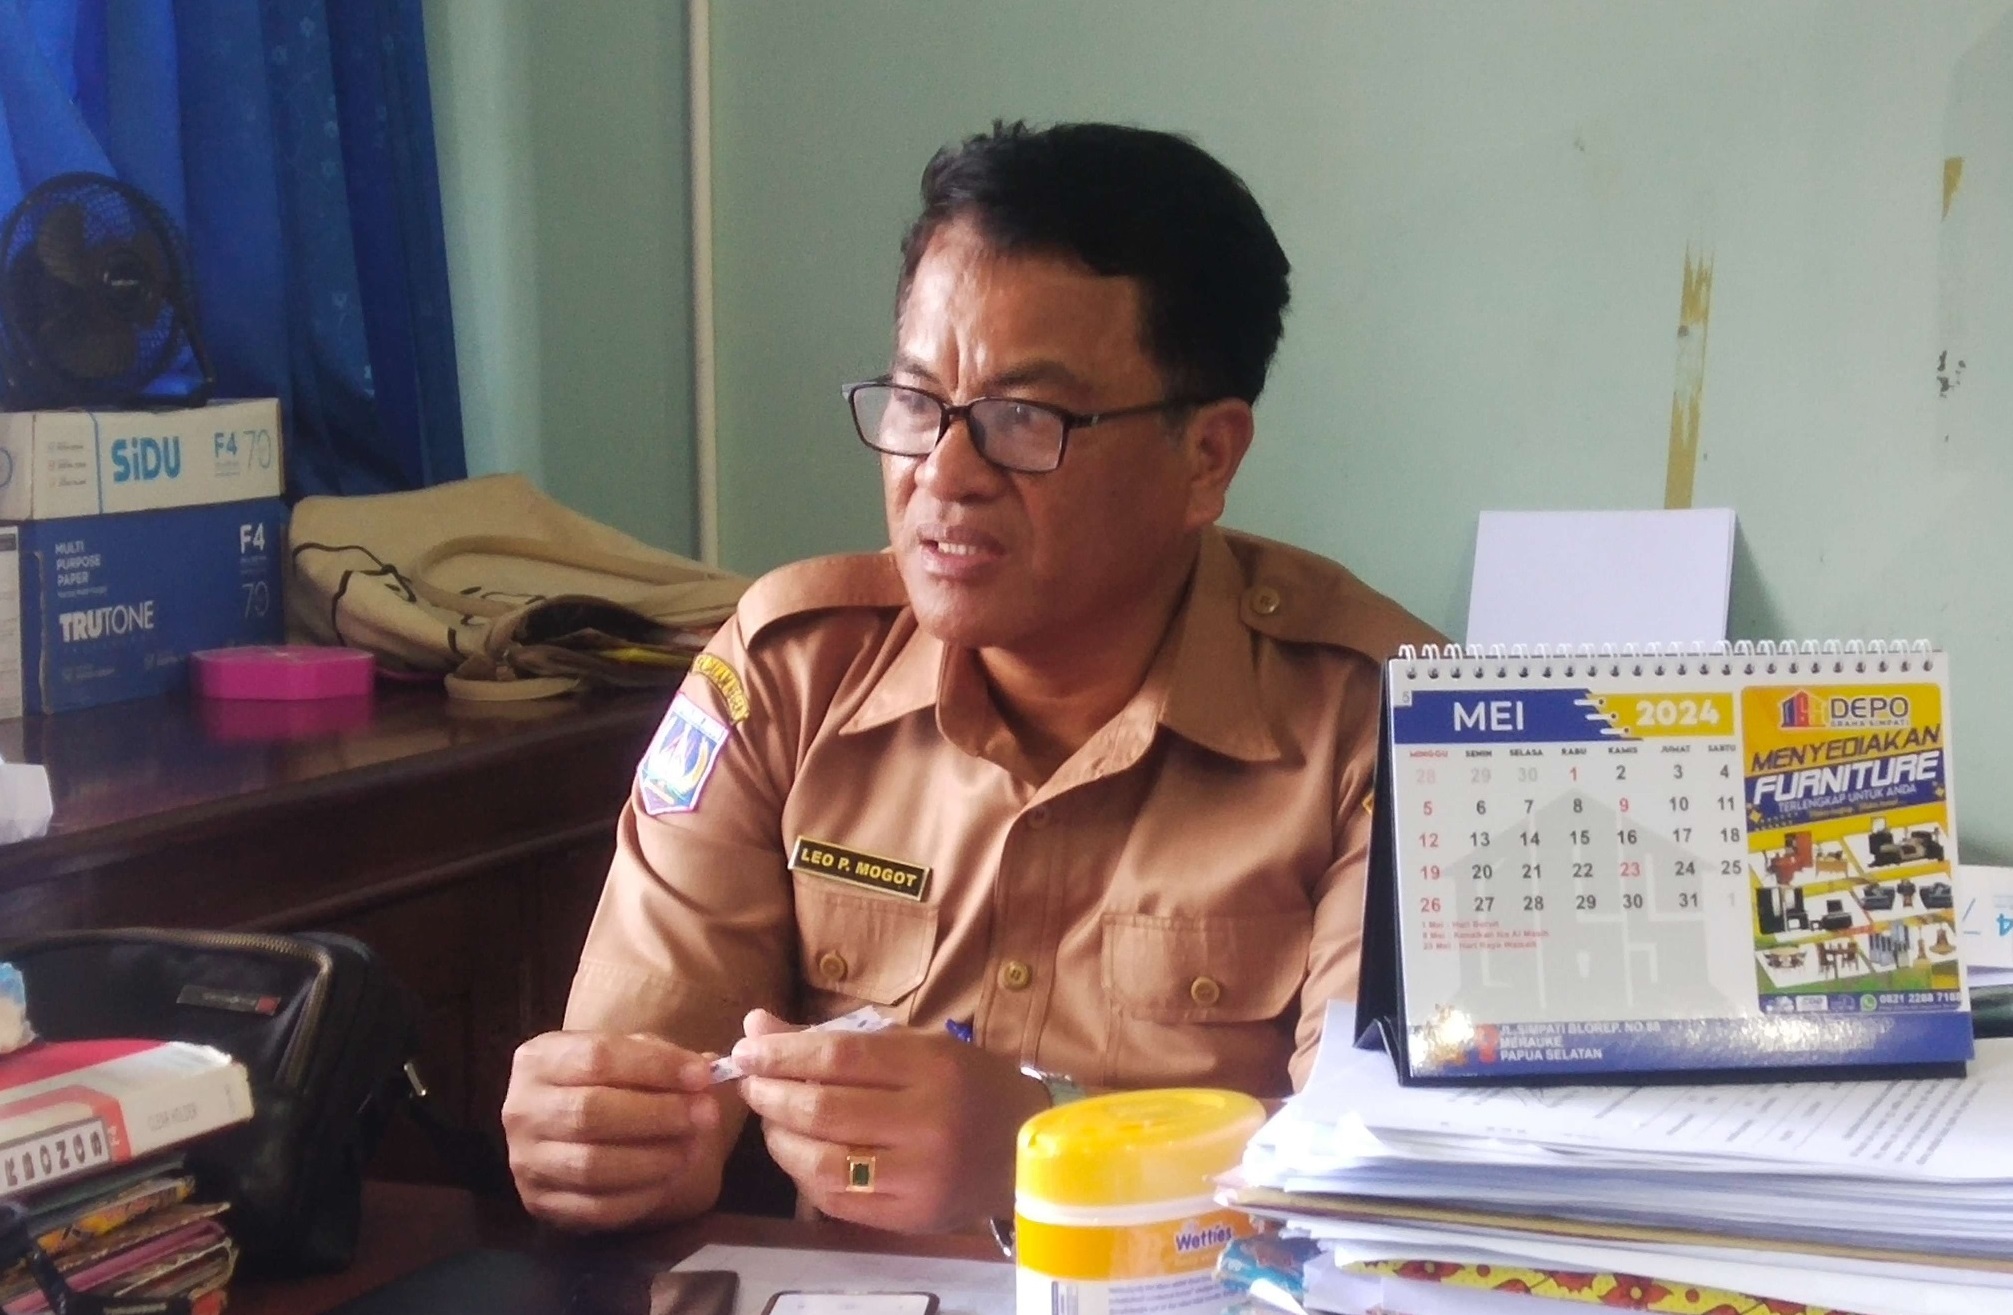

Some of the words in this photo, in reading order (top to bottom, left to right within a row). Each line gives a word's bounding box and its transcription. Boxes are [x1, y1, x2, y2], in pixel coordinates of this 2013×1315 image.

[214, 432, 238, 458] F4
[244, 429, 271, 470] 70
[55, 540, 85, 555] MULTI
[240, 523, 266, 554] F4
[56, 553, 101, 571] PURPOSE
[58, 572, 89, 587] PAPER
[59, 601, 155, 642] TRUTONE
[1453, 701, 1525, 731] MEI
[1636, 699, 1719, 726] 2024
[1752, 724, 1940, 772] MENYEDIAKAN
[1416, 768, 1436, 784] 28
[1471, 768, 1491, 783] 29
[1518, 767, 1537, 782] 30
[1570, 767, 1577, 781] 1
[1616, 766, 1626, 780] 2
[1674, 765, 1683, 779] 3
[1720, 765, 1729, 778] 4
[1754, 751, 1940, 805] FURNITURE
[1423, 802, 1433, 815] 5
[1476, 801, 1486, 815] 6
[1524, 800, 1533, 814] 7
[1573, 799, 1582, 813] 8
[1619, 798, 1629, 813] 9
[1670, 798, 1689, 811] 10
[1718, 797, 1735, 810] 11
[1779, 794, 1846, 813] TERLENGKAP
[1849, 789, 1882, 803] UNTUK
[1886, 784, 1916, 795] ANDA
[1419, 833, 1438, 848] 12
[1471, 832, 1490, 847] 13
[1520, 832, 1540, 846] 14
[1570, 831, 1590, 845] 15
[1618, 830, 1637, 844] 16
[1673, 829, 1691, 843] 17
[1721, 828, 1740, 842] 18
[801, 847, 835, 867] LEO
[837, 858, 850, 873] P.
[855, 862, 917, 888] MOGOT
[1421, 866, 1440, 880] 19
[1472, 865, 1492, 879] 20
[1523, 864, 1542, 878] 21
[1573, 863, 1593, 877] 22
[1620, 862, 1640, 877] 23
[1675, 861, 1695, 875] 24
[1721, 861, 1741, 875] 25
[1421, 898, 1441, 912] 26
[1475, 897, 1494, 911] 27
[1524, 897, 1544, 910] 28
[1577, 895, 1596, 910] 29
[1623, 894, 1643, 909] 30
[1679, 893, 1698, 907] 31
[1501, 1036, 1562, 1048] MERAUKE
[1501, 1049, 1542, 1060] PAPUA
[1546, 1049, 1602, 1060] SELATAN
